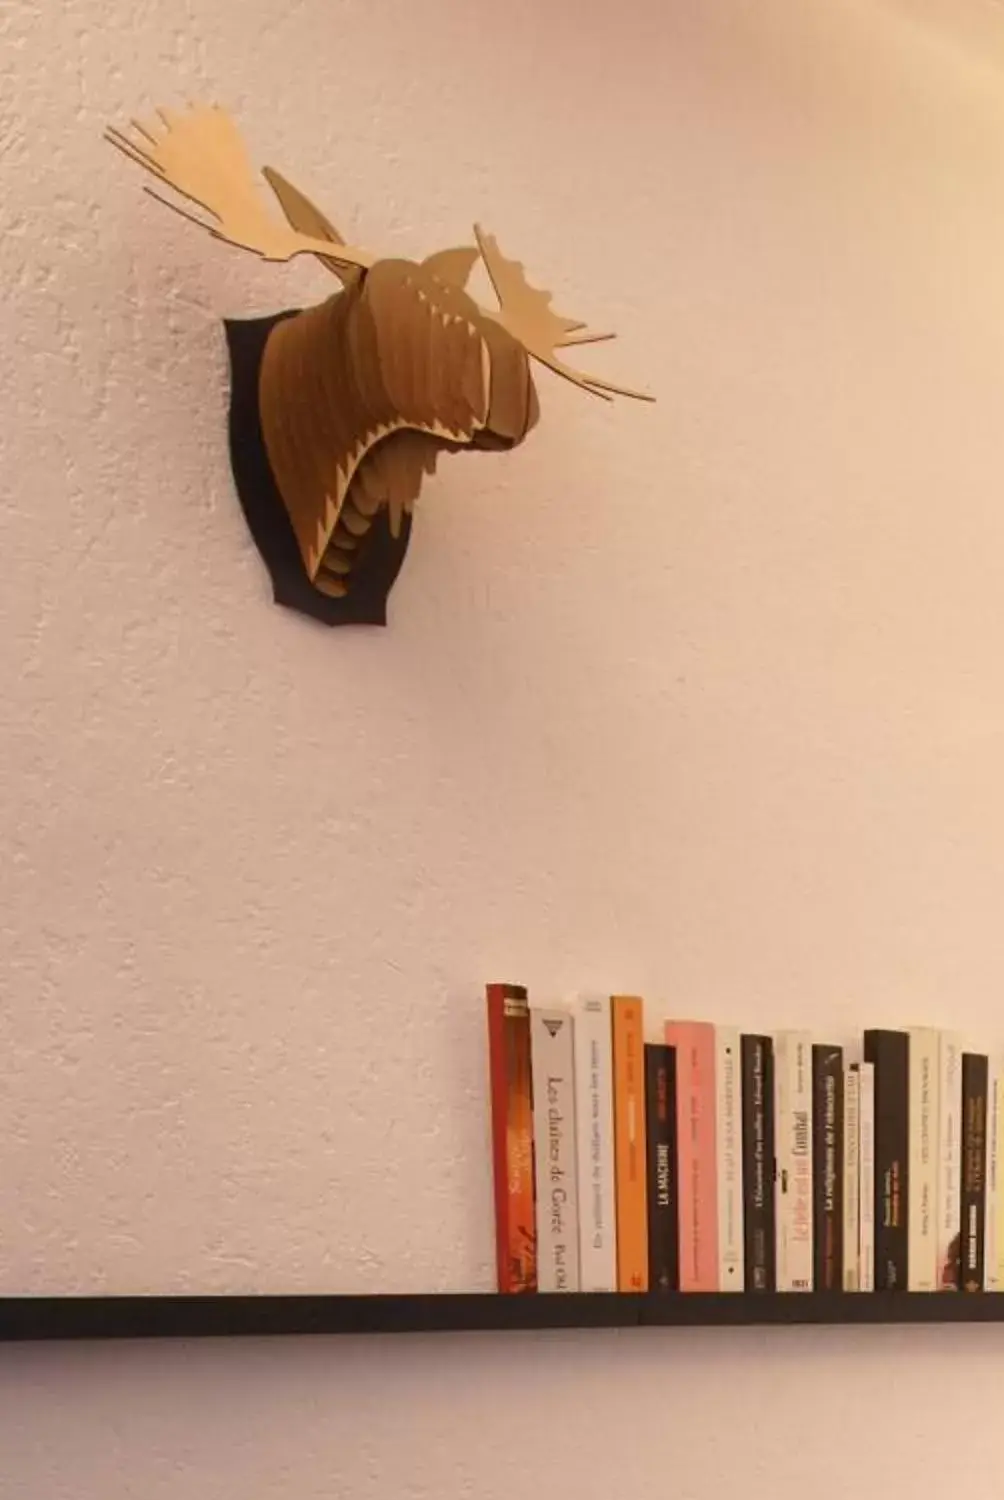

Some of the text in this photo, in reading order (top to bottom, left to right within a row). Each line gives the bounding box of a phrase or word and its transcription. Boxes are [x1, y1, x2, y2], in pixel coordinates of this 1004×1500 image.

[548, 1077, 564, 1103] Les
[791, 1111, 808, 1156] Combat
[824, 1132, 834, 1145] de
[550, 1166, 565, 1182] de
[657, 1143, 669, 1205] LA MACHINE
[550, 1188, 566, 1234] Gorée
